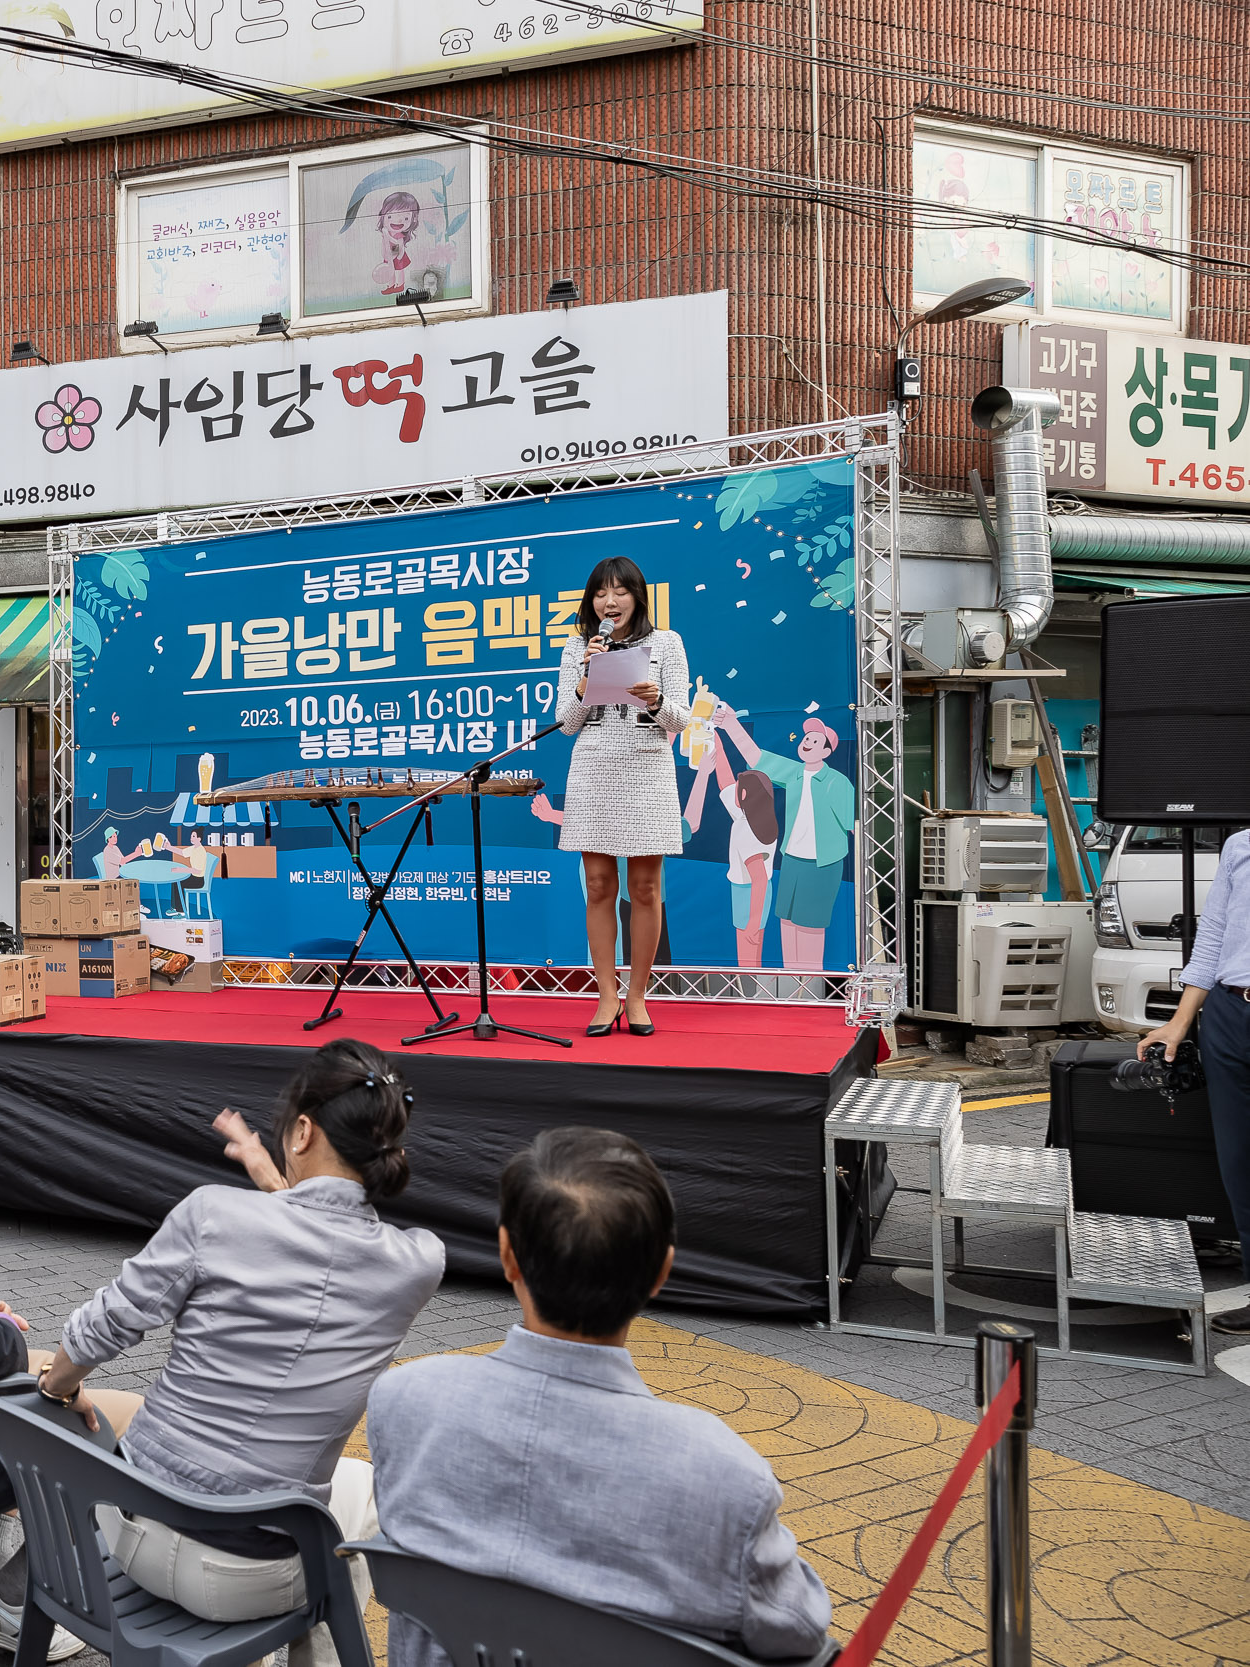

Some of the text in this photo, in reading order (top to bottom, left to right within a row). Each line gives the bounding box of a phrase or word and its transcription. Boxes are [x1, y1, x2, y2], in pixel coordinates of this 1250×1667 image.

[152, 222, 193, 242] 클래식,
[235, 210, 282, 231] 실용음악
[147, 232, 288, 262] 교회반주, 리코더, 관현악
[1039, 336, 1097, 379] 고가구
[115, 336, 597, 446] 사임당 떡 고을
[302, 546, 534, 603] 능동로골목시장
[187, 608, 402, 680] 가을낭만
[240, 709, 283, 727] 2023.
[299, 719, 537, 760] 능동로골목시장 내
[290, 871, 305, 883] MC
[313, 870, 346, 884] 노현지
[426, 871, 449, 884] 대상
[484, 870, 551, 885] 홍삼트리오
[425, 887, 468, 901] 한유빈,
[81, 964, 112, 974] A1610N
